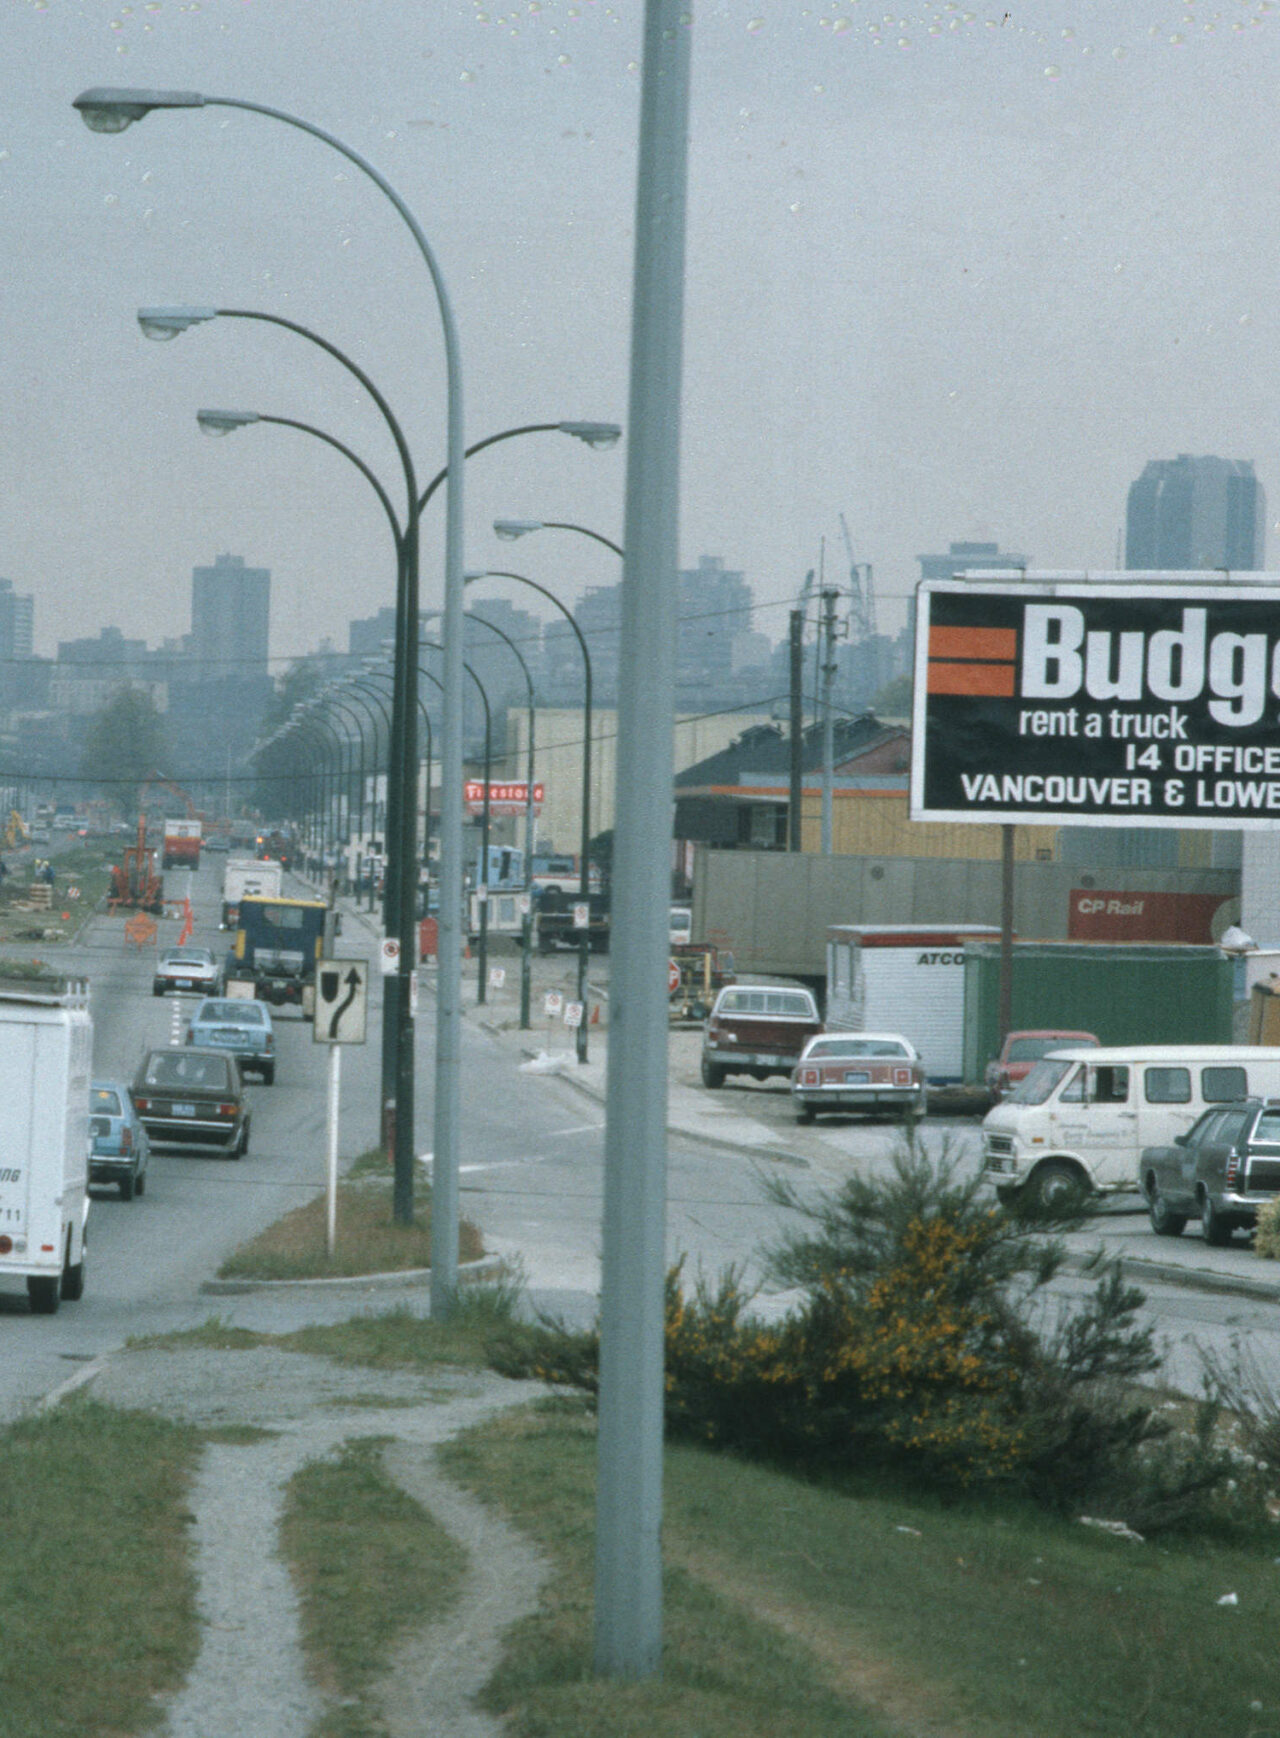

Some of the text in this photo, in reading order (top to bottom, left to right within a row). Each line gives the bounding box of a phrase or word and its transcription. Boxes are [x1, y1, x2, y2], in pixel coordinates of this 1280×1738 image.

[1021, 604, 1280, 727] Budg
[1019, 706, 1189, 739] rent a truck
[1126, 744, 1161, 771] 14
[961, 774, 1151, 806] VANCOUVER
[1165, 779, 1184, 807] &
[1078, 899, 1144, 915] CP Rail
[917, 952, 965, 966] ATCO
